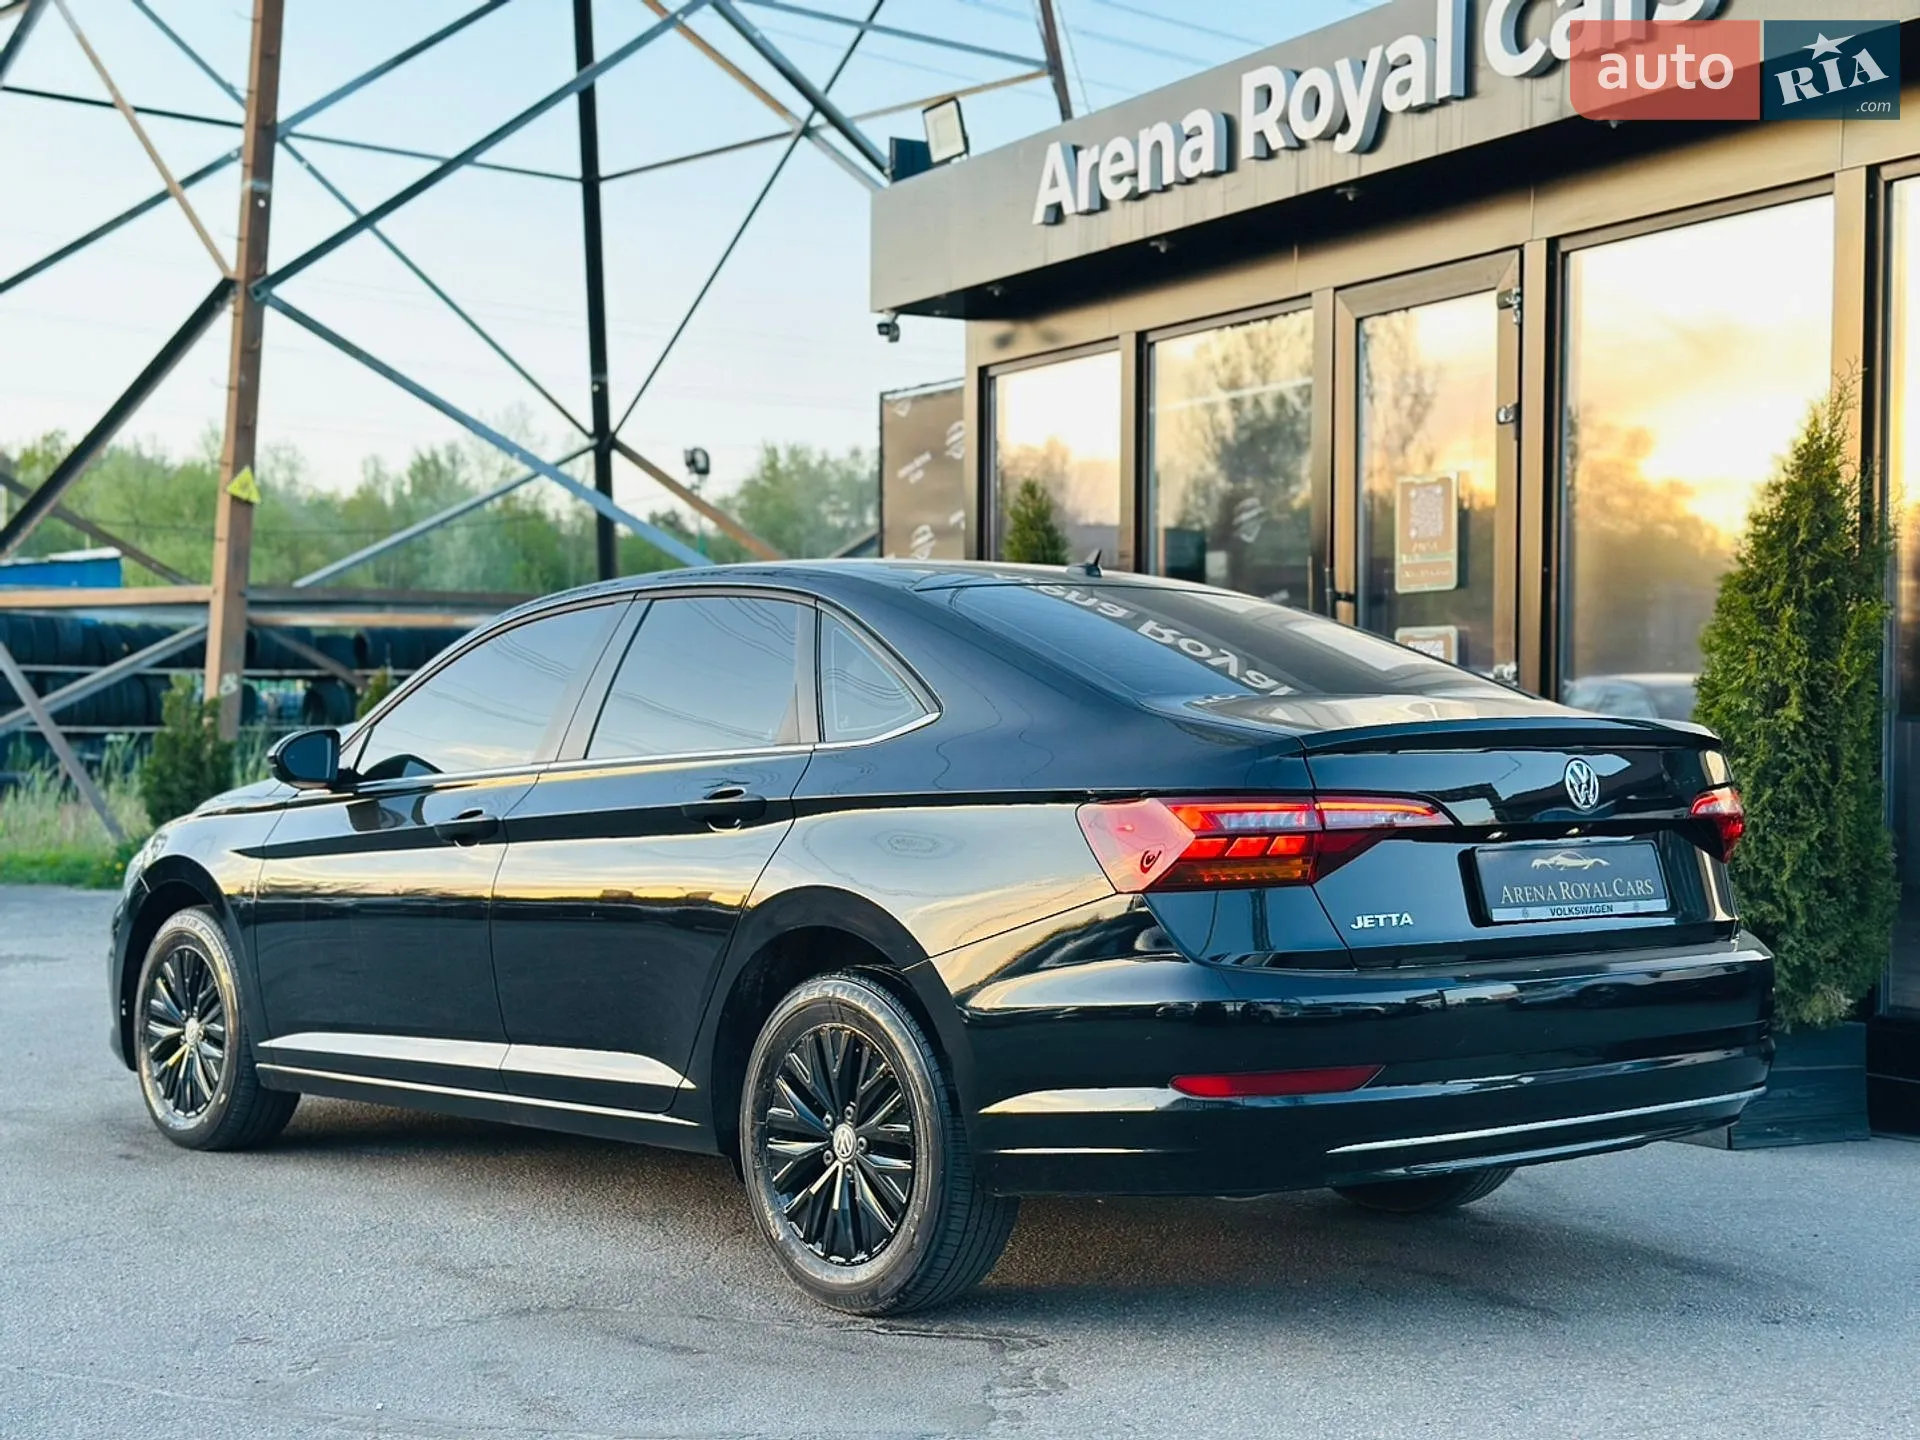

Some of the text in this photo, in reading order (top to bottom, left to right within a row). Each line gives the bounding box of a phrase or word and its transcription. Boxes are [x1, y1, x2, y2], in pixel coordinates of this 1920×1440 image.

[1032, 108, 1224, 224] Arena
[1241, 0, 1462, 159] Royal
[1501, 878, 1654, 904] ARENA ROYAL CARS
[1350, 912, 1414, 930] JETTA
[1550, 904, 1613, 917] VOLKSWAGEN
